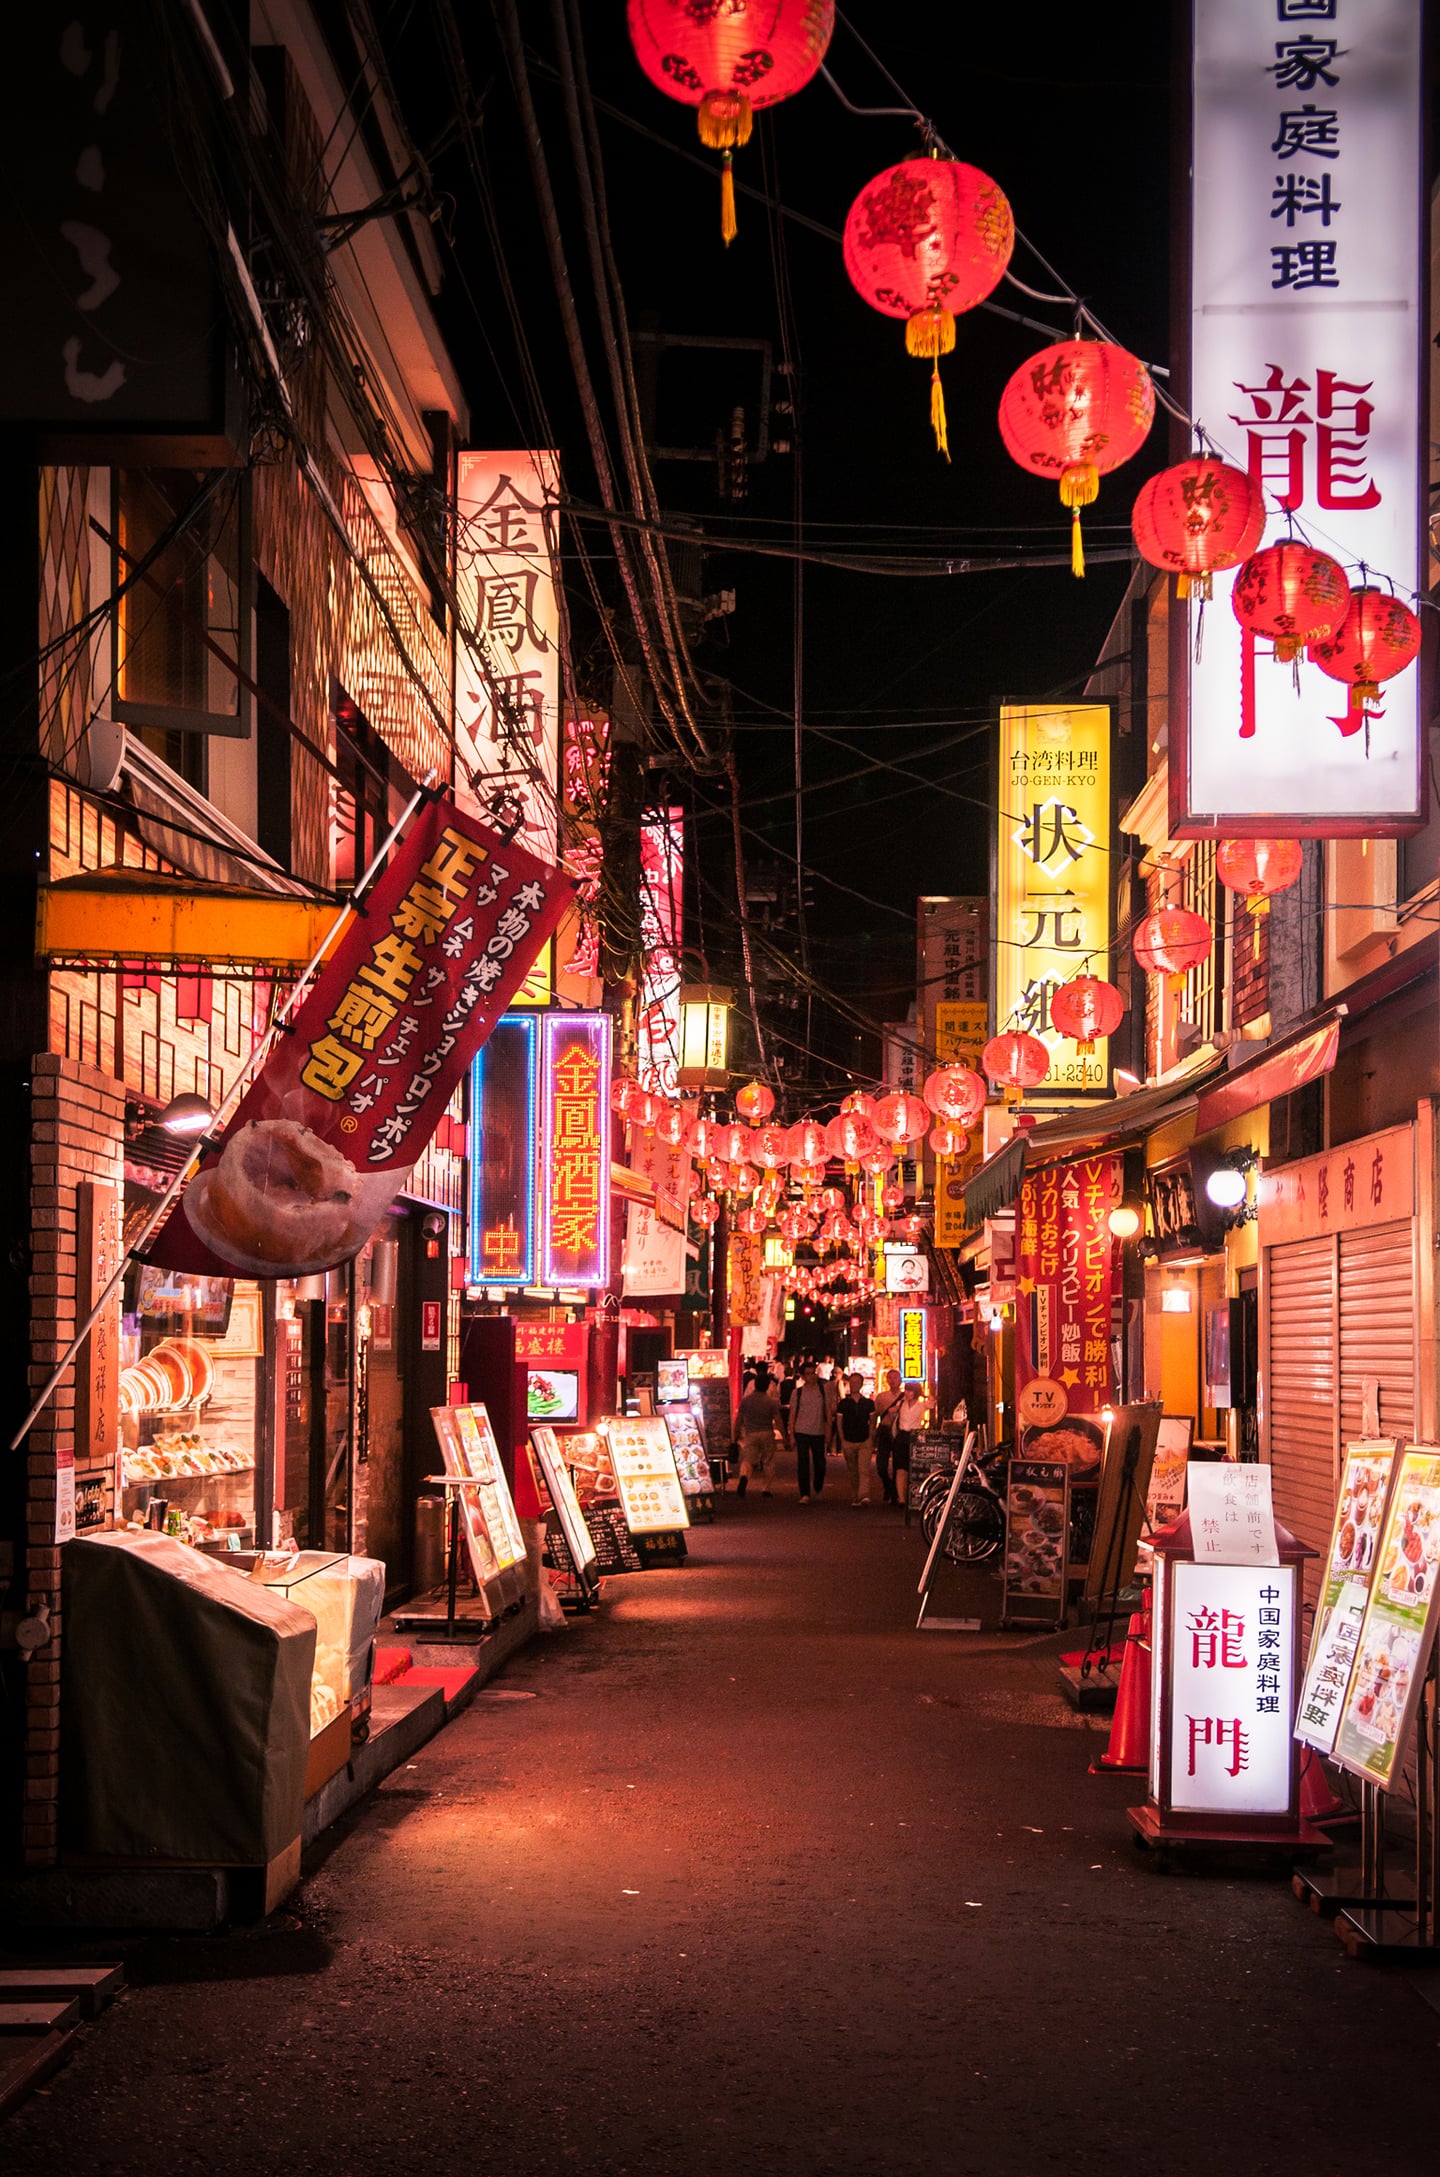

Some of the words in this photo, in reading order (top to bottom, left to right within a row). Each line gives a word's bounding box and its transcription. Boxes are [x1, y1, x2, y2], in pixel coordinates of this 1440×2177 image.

[1010, 750, 1098, 771] 台湾料理
[1011, 775, 1096, 786] JO-GEN-KYO
[300, 827, 489, 1101] 正宗生煎包
[551, 1046, 600, 1252] 金鳳酒家
[1033, 1392, 1054, 1402] TV
[1202, 1518, 1222, 1552] 禁止
[1256, 1584, 1281, 1713] 中国家庭料理
[1185, 1604, 1250, 1777] 龍門
